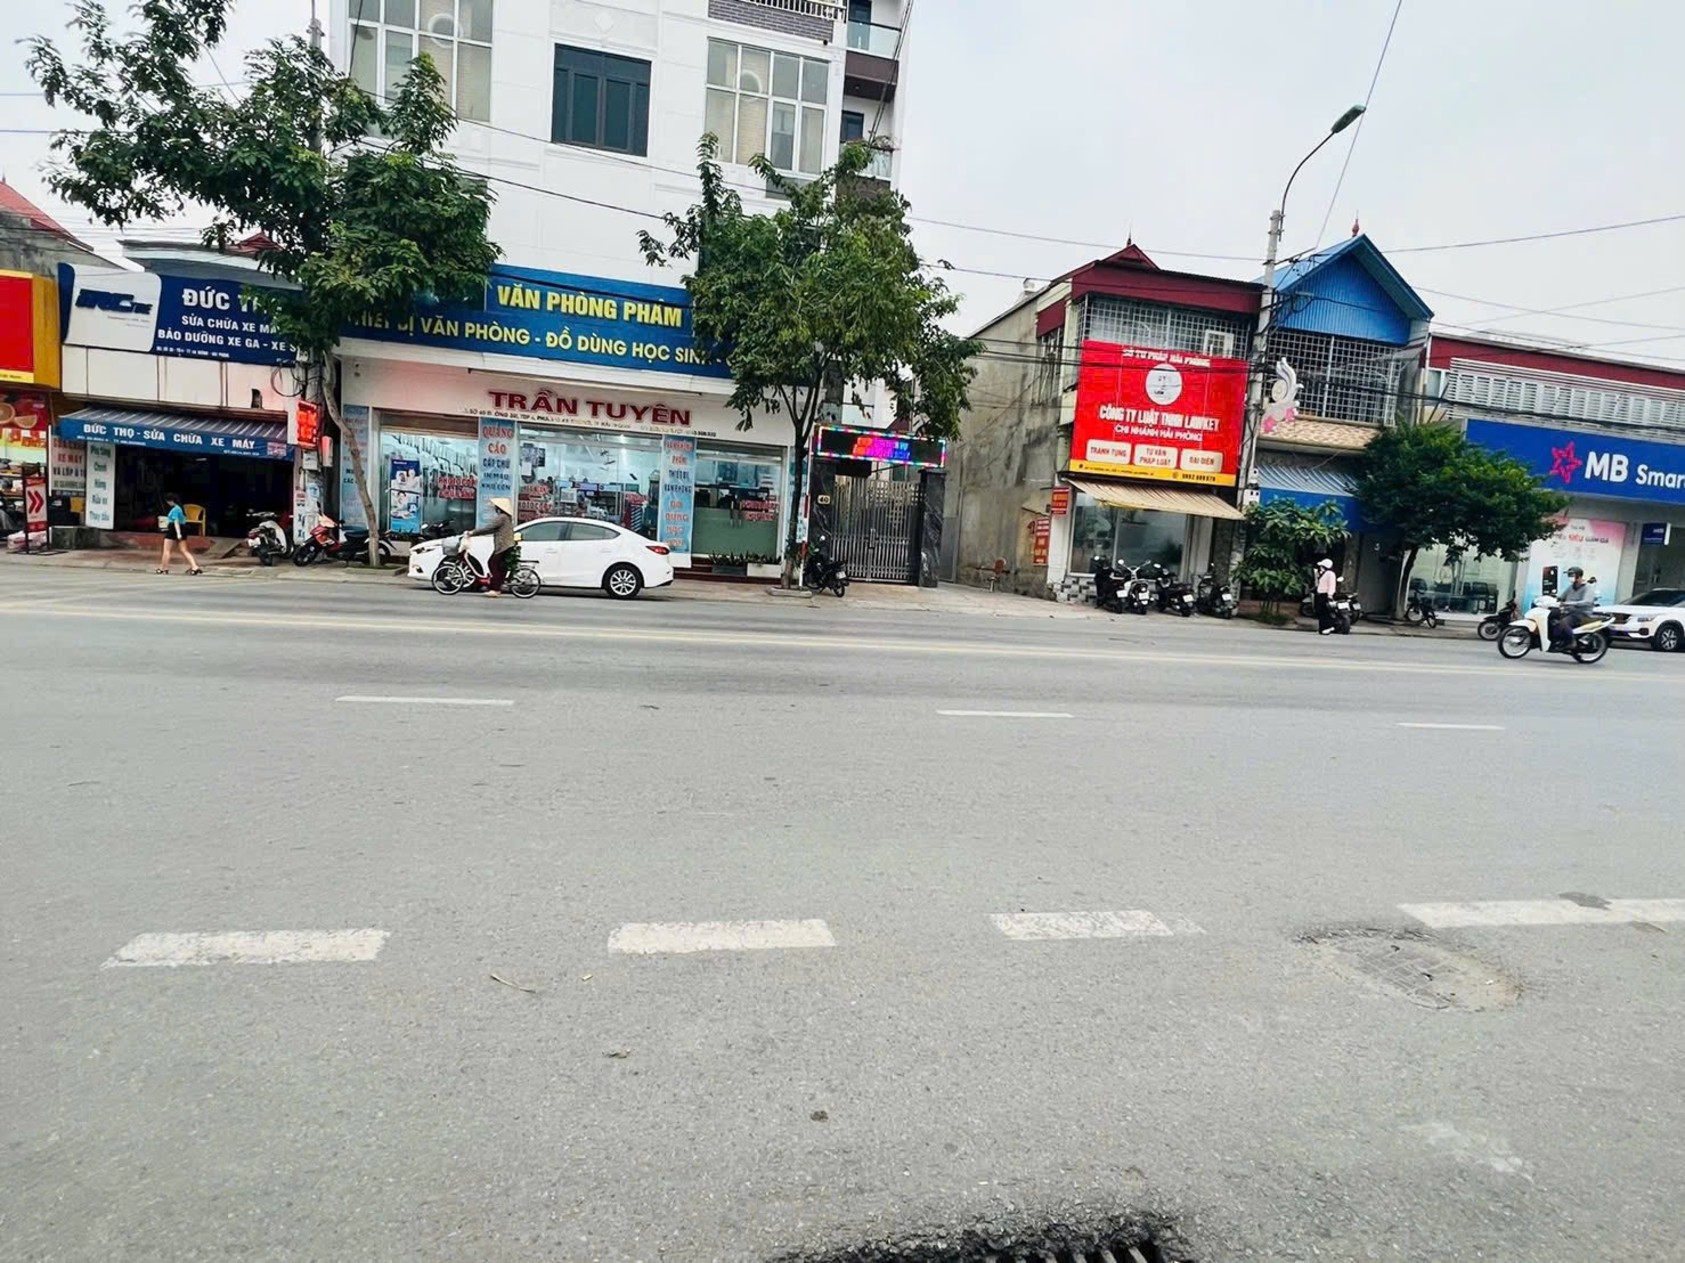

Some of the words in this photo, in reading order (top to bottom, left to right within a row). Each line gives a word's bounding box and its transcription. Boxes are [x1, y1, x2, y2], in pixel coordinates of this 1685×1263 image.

[182, 286, 230, 310] ĐỨC
[497, 283, 540, 310] VĂN
[546, 291, 618, 320] PHÒNG
[182, 313, 204, 327] SỬA
[207, 317, 239, 331] CHỮA
[242, 322, 256, 333] XE
[157, 327, 181, 341] BẢO
[228, 336, 241, 347] XE
[245, 338, 260, 349] GA
[271, 341, 286, 352] XE
[421, 315, 459, 337] VĂN
[464, 321, 530, 346] PHÒNG
[546, 326, 573, 350] ĐỒ
[577, 332, 627, 356] DÙNG
[632, 342, 670, 363] HỌC
[488, 388, 578, 415] TRẦN
[586, 401, 690, 426] TUYÊN
[1125, 408, 1136, 422] TY
[83, 422, 107, 435] ĐỨC
[113, 427, 134, 439] THỌ
[143, 428, 165, 441] SỬA
[173, 432, 203, 445] CHỮA
[211, 437, 224, 447] XE
[232, 438, 256, 449] MÁY
[1114, 424, 1129, 434] CHI
[1130, 425, 1158, 437] NHÁNH
[1175, 430, 1203, 441] PHÒNG
[1585, 451, 1629, 483] MB
[1635, 464, 1685, 489] Smar
